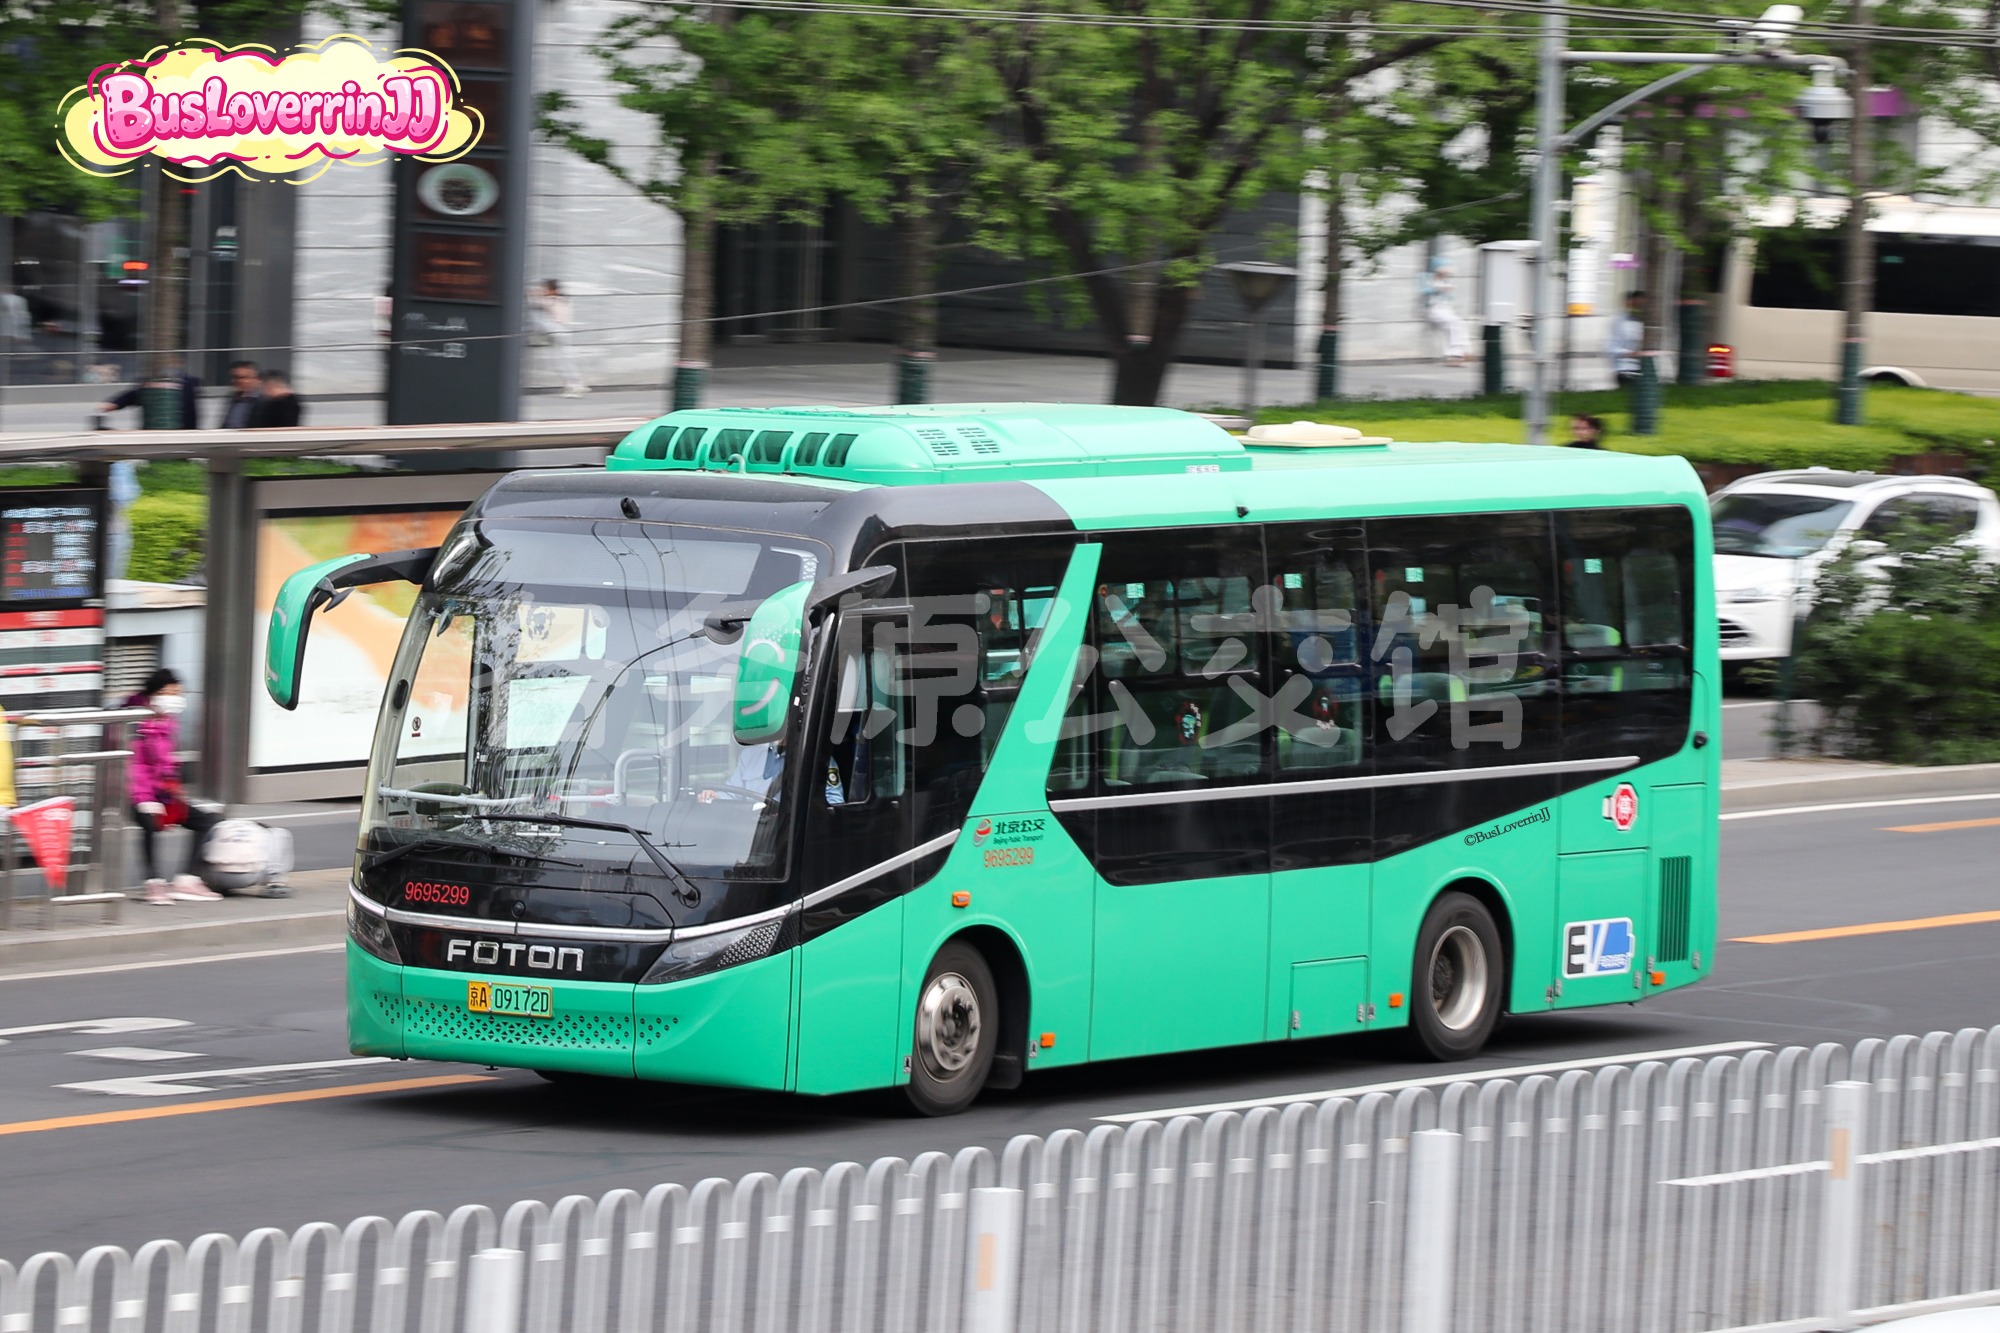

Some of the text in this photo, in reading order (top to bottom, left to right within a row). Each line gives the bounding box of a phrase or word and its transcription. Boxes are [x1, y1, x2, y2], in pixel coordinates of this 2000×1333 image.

[994, 818, 1046, 835] 北京公交
[983, 846, 1034, 869] 9695299
[404, 881, 470, 906] 9695299
[446, 938, 585, 972] FOTON
